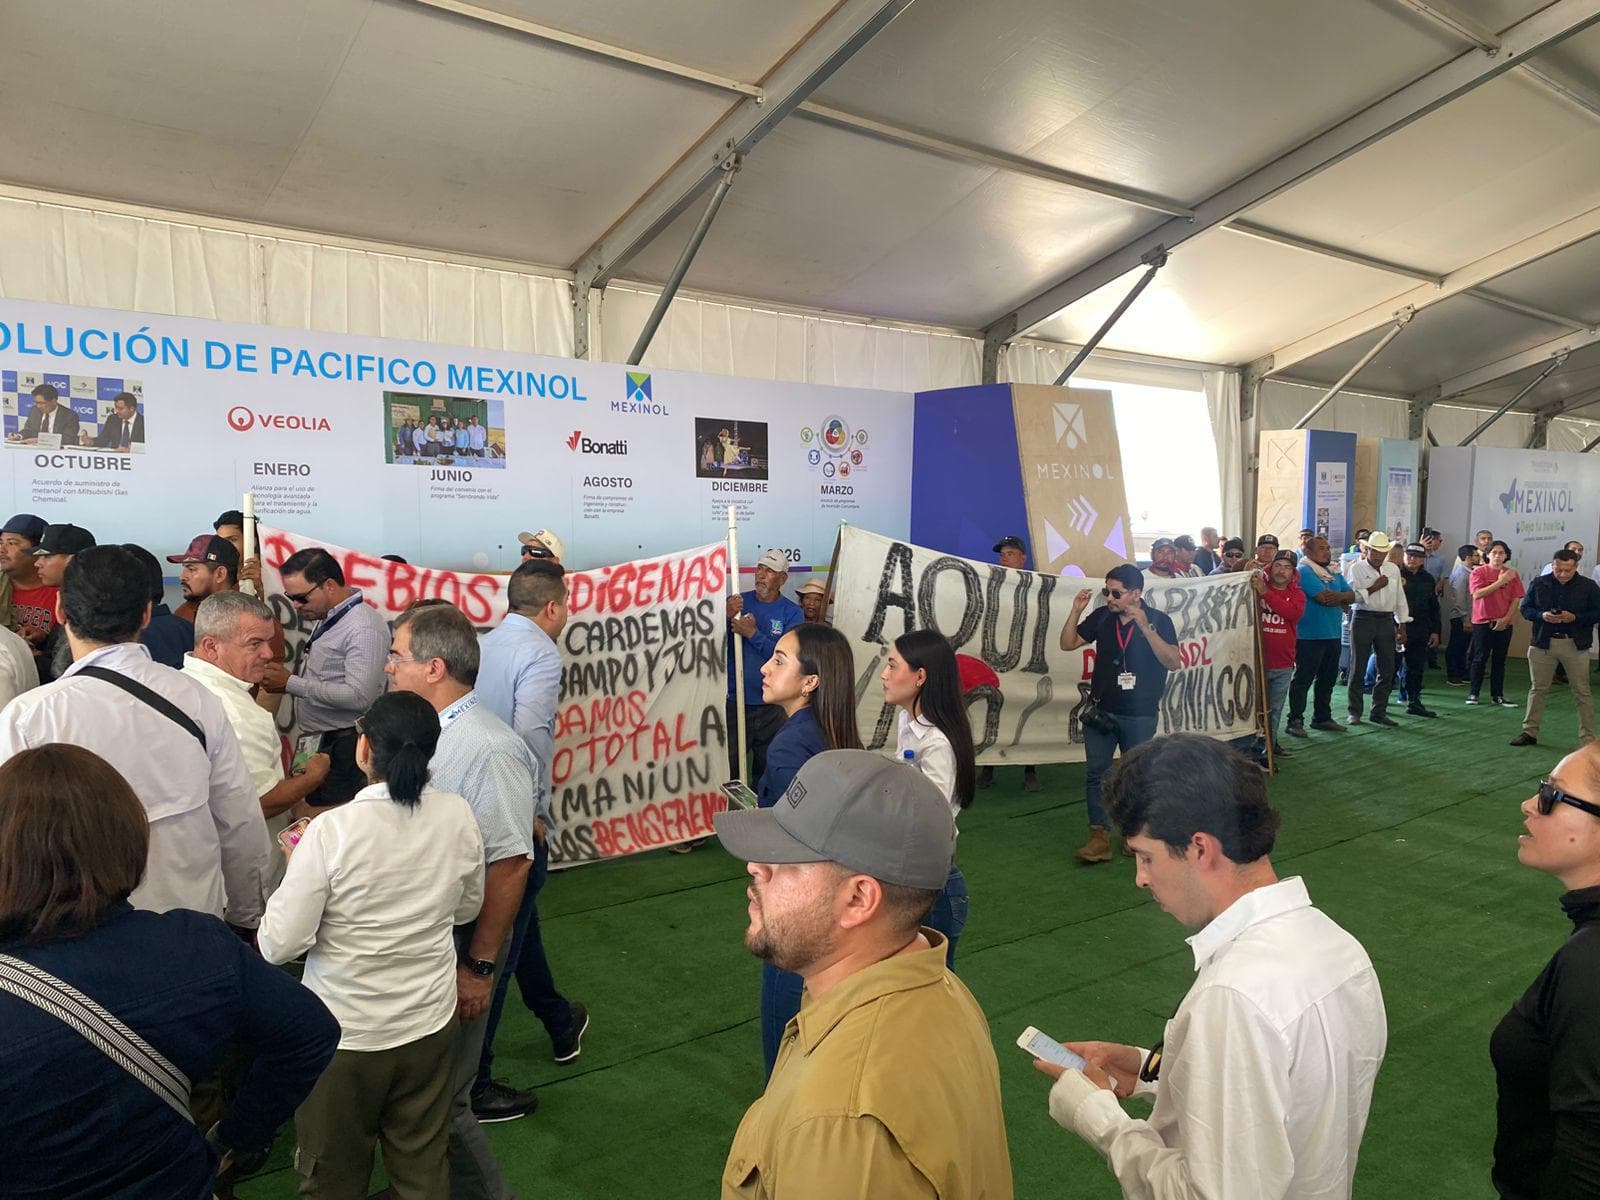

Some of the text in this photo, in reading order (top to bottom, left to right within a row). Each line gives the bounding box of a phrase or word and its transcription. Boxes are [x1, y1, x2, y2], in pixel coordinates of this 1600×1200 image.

[205, 340, 258, 374] DE
[270, 346, 437, 387] PACIFICO
[447, 363, 588, 401] MEXINOL
[611, 401, 670, 416] MEXINOL
[258, 414, 331, 431] VEOLIA
[582, 438, 628, 455] Bonatti
[34, 454, 132, 471] OCTUBRE
[253, 462, 311, 476] ENERO
[430, 469, 472, 482] JUNIO
[1036, 463, 1115, 480] MEXINOL
[32, 478, 62, 486] Acuerdo
[583, 476, 633, 488] AGOSTO
[711, 481, 768, 493] DICIEMBRE
[77, 488, 113, 496] Mitsubishi
[820, 485, 854, 496] MARZO
[32, 495, 67, 503] Chemical.
[1514, 489, 1574, 513] MEXINOL
[565, 599, 715, 656] CARDENAS
[644, 645, 664, 693] Y
[663, 632, 727, 685] JUAN
[577, 713, 698, 774] TOTAL
